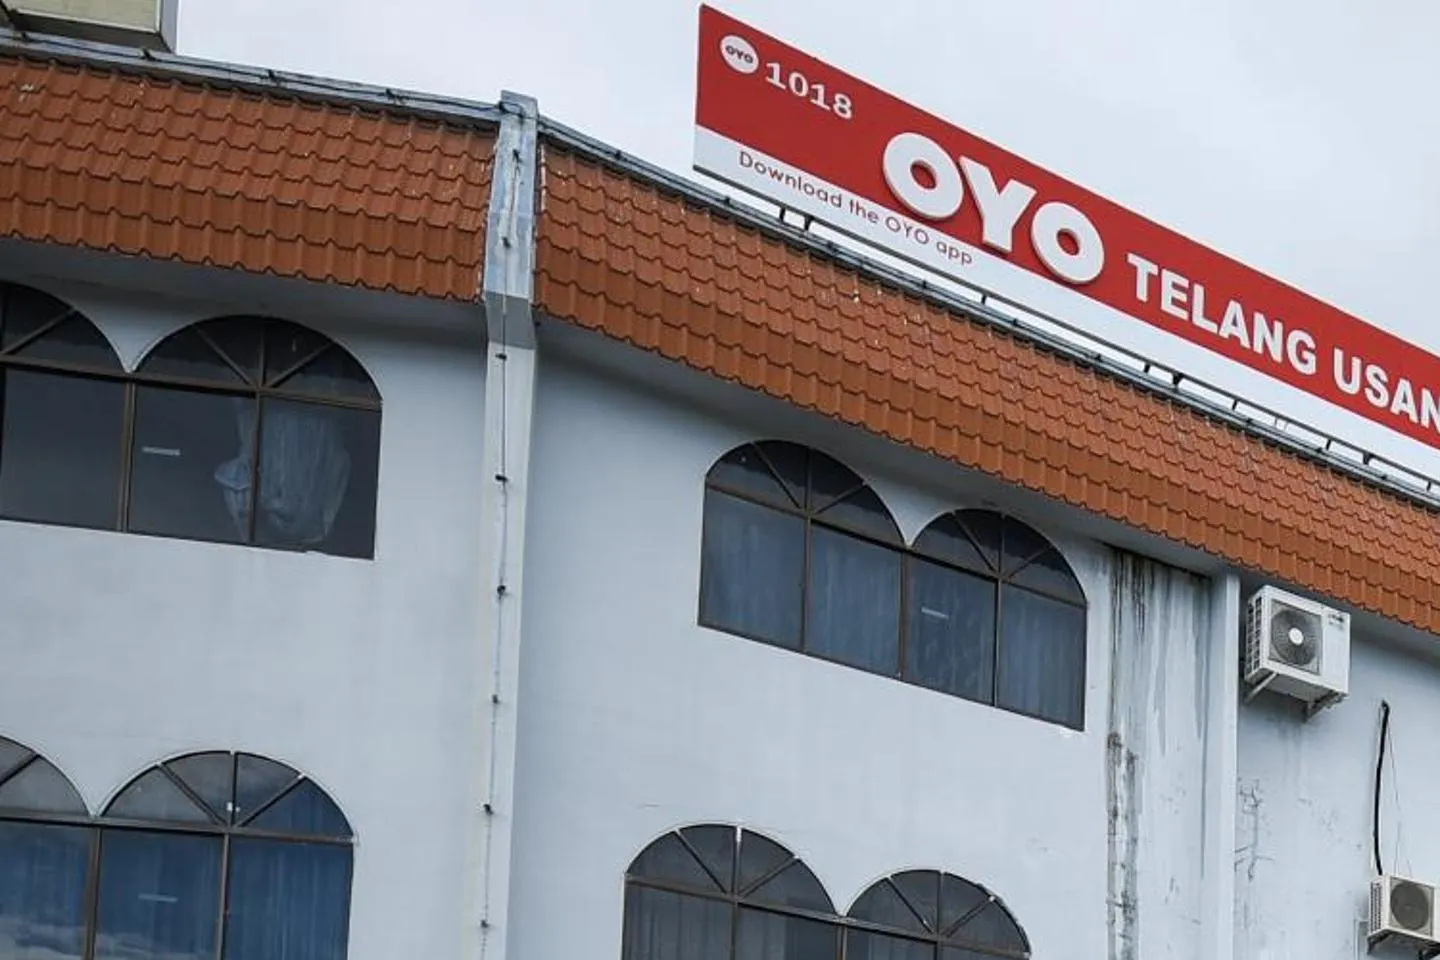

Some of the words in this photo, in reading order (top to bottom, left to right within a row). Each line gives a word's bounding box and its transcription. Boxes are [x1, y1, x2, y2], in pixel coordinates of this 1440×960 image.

[725, 44, 754, 65] OYO
[766, 62, 852, 119] 1018
[739, 150, 843, 208] Download
[849, 199, 880, 225] the
[885, 216, 930, 246] OYO
[936, 240, 974, 266] app
[882, 131, 1105, 285] OYO
[1127, 252, 1317, 375] TELANG
